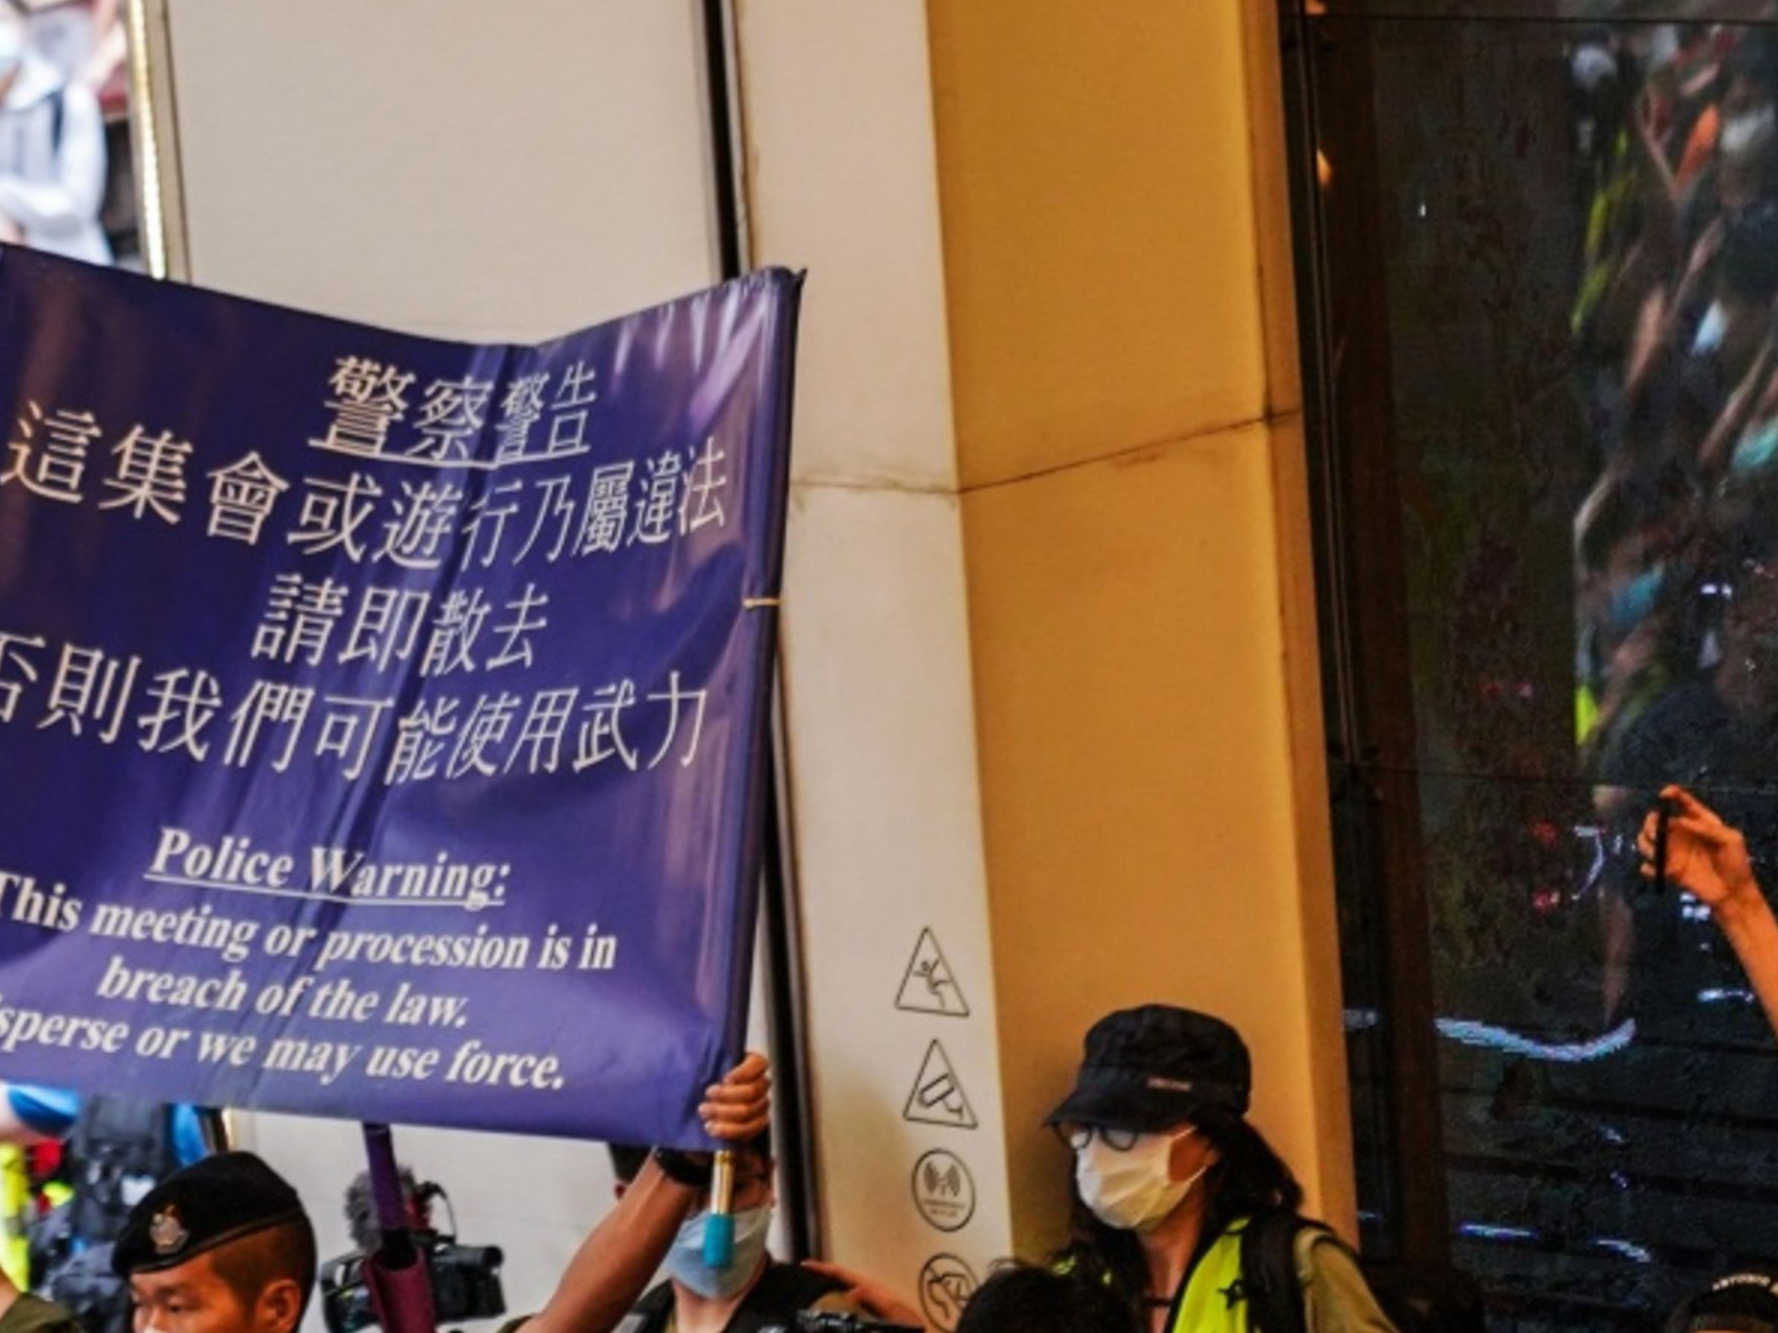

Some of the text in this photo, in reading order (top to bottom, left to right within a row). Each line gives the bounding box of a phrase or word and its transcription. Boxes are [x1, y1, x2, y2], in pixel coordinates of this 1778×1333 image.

[327, 353, 599, 457] 警察警告
[250, 577, 549, 677] 請即散去
[149, 828, 511, 911] Police Warning:
[88, 904, 260, 963] meeting
[264, 925, 318, 957] or
[321, 927, 530, 970] procession
[537, 924, 572, 969] is
[578, 922, 617, 969] in
[97, 954, 466, 1028] breach of the law.
[135, 1027, 191, 1059] or
[198, 1032, 257, 1066] we
[263, 1040, 349, 1085] may
[366, 1047, 440, 1080] use
[445, 1040, 564, 1090] force.
